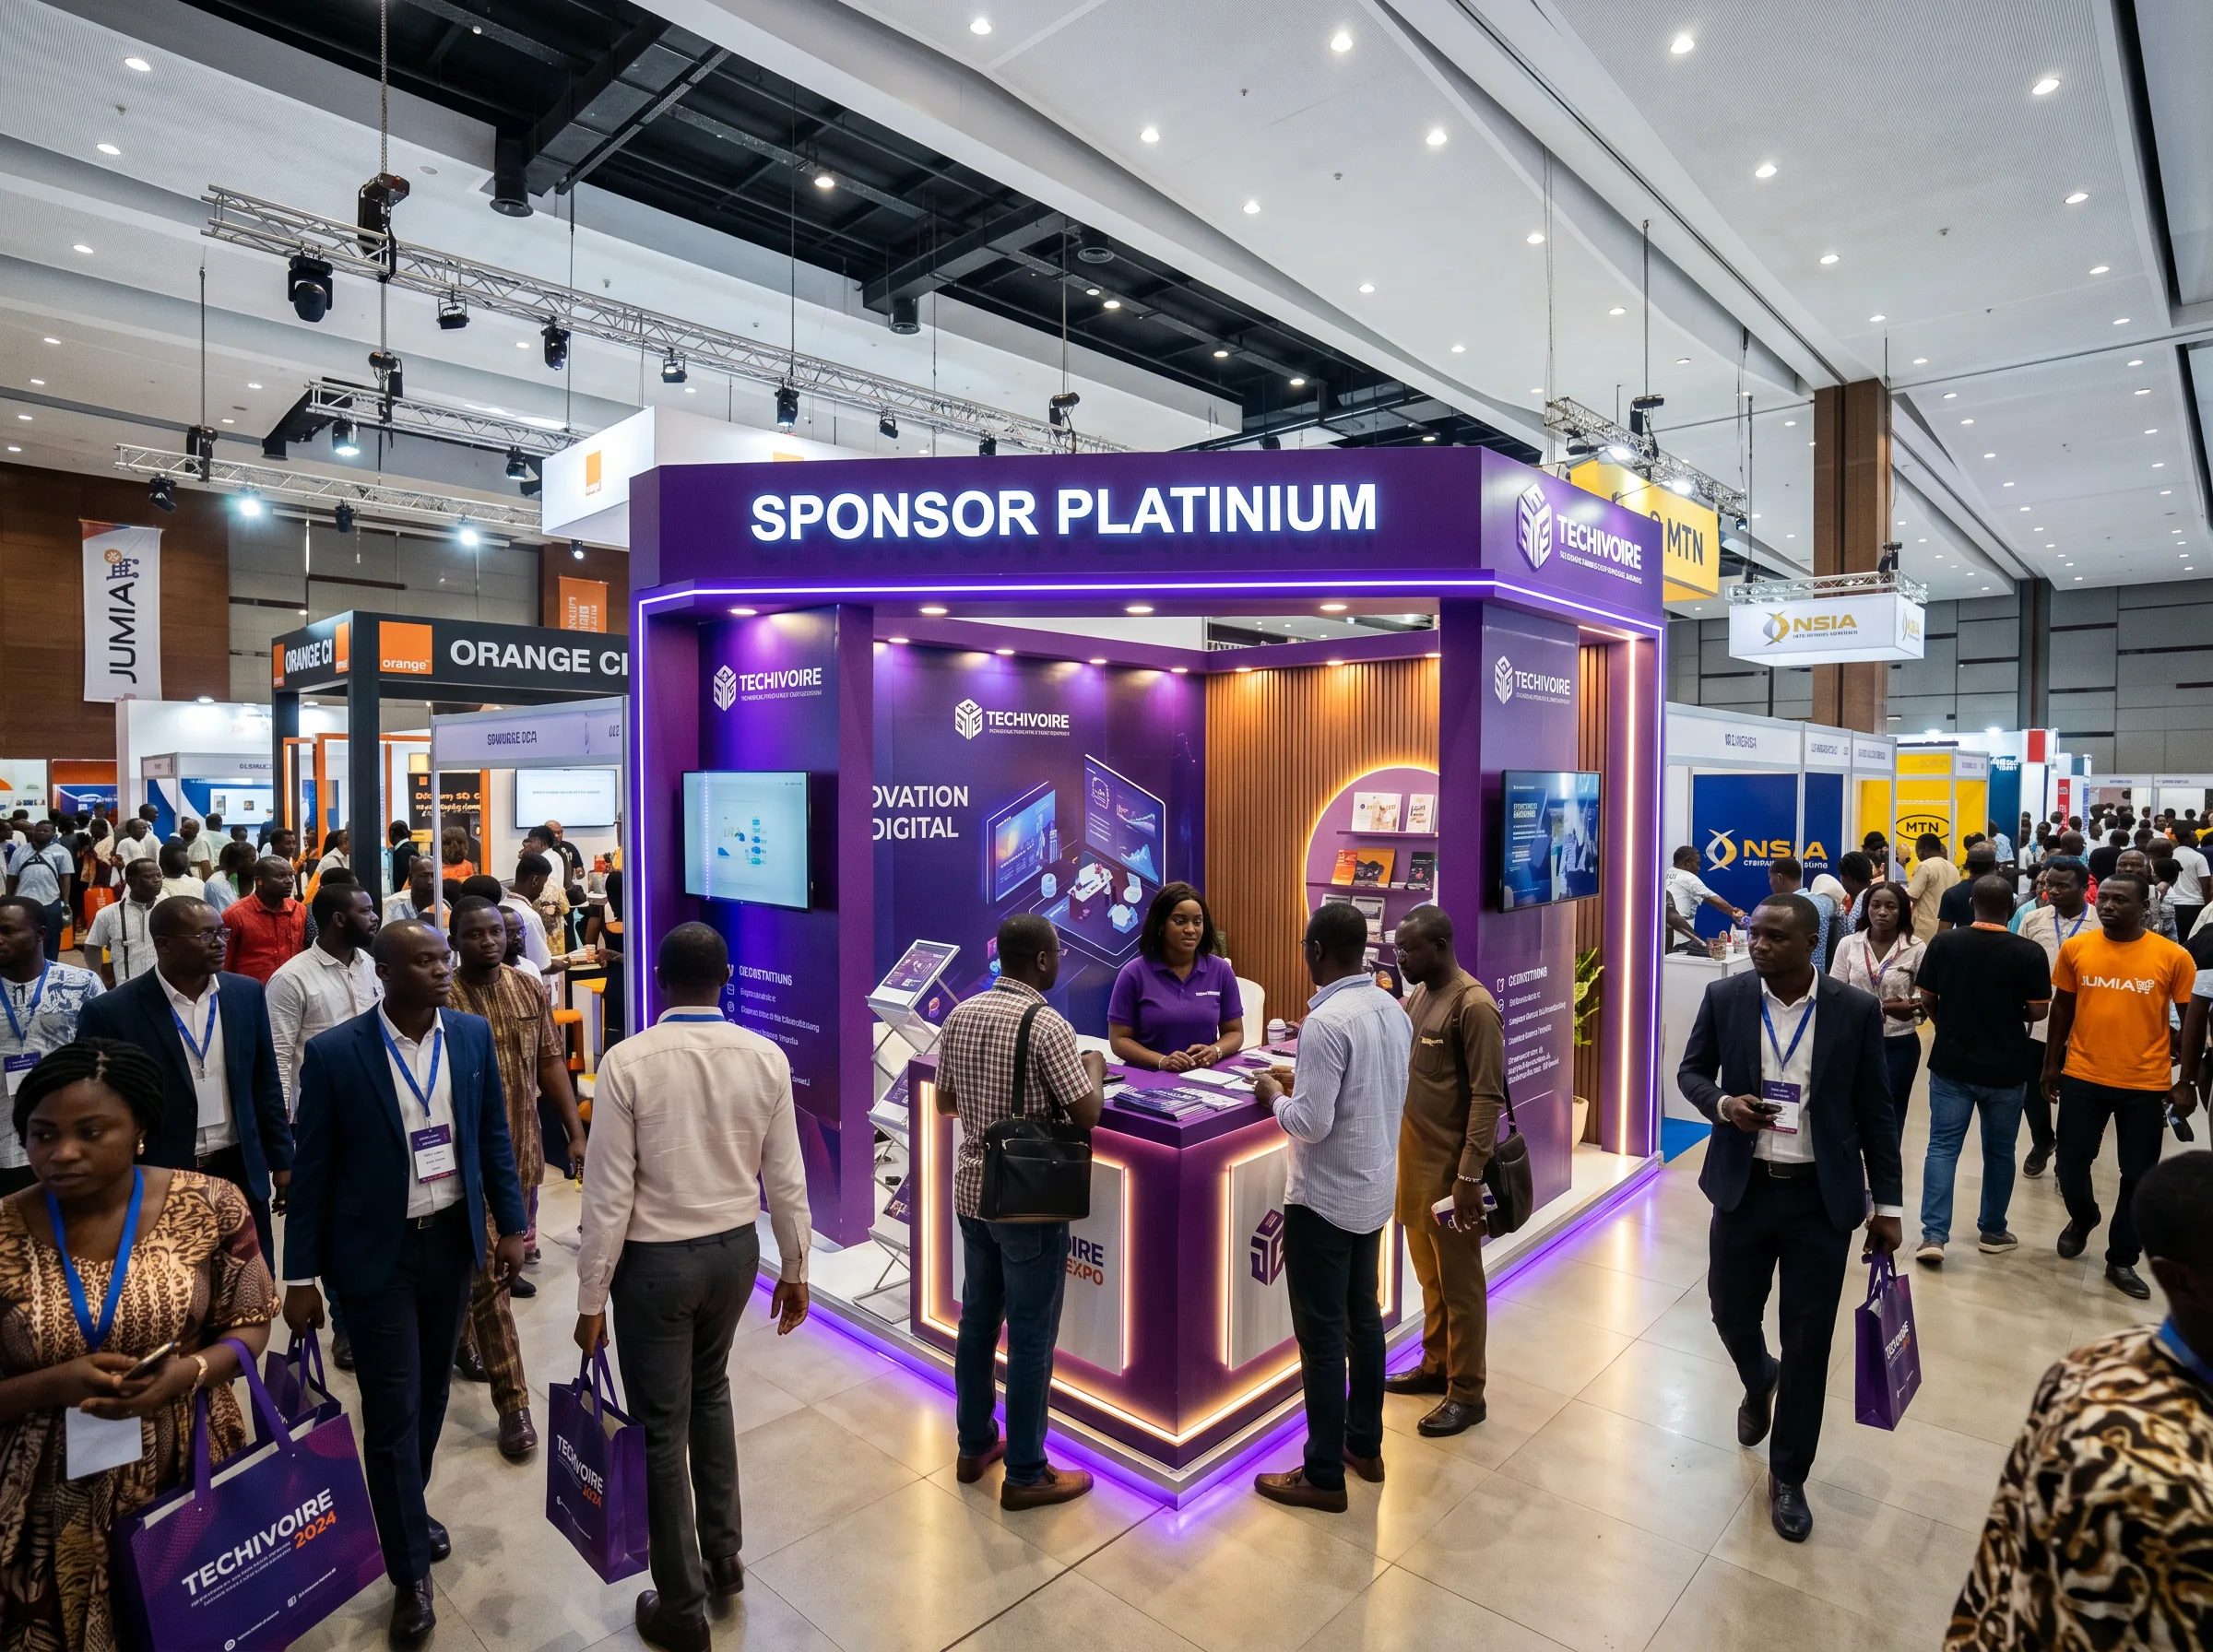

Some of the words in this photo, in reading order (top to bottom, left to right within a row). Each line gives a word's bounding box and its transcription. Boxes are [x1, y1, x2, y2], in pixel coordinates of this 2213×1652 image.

[751, 490, 1039, 542] SPONSOR
[1058, 483, 1376, 536] PLATINIUM
[1556, 513, 1642, 571] TECHIVOIRE
[1667, 517, 1703, 566] MTN
[108, 582, 137, 684] JUMIA
[1793, 614, 1857, 632] NSIA
[285, 643, 321, 674] ORANGE
[322, 639, 333, 665] CI
[383, 658, 428, 672] orange
[450, 639, 591, 674] ORANGE
[599, 651, 629, 676] CI
[739, 667, 822, 691] TECHIVOIRE
[1515, 670, 1570, 696] TECHIVOIRE
[986, 711, 1070, 729] TECHIVOIRE
[872, 816, 959, 841] DIGITAL
[1906, 821, 1939, 833] MTN
[2081, 975, 2136, 992] JUMIA
[1068, 1235, 1104, 1268] IRE
[1065, 1257, 1104, 1286] EXPO
[182, 1488, 334, 1597] TECHIVOIRE
[293, 1510, 337, 1550] 2024
